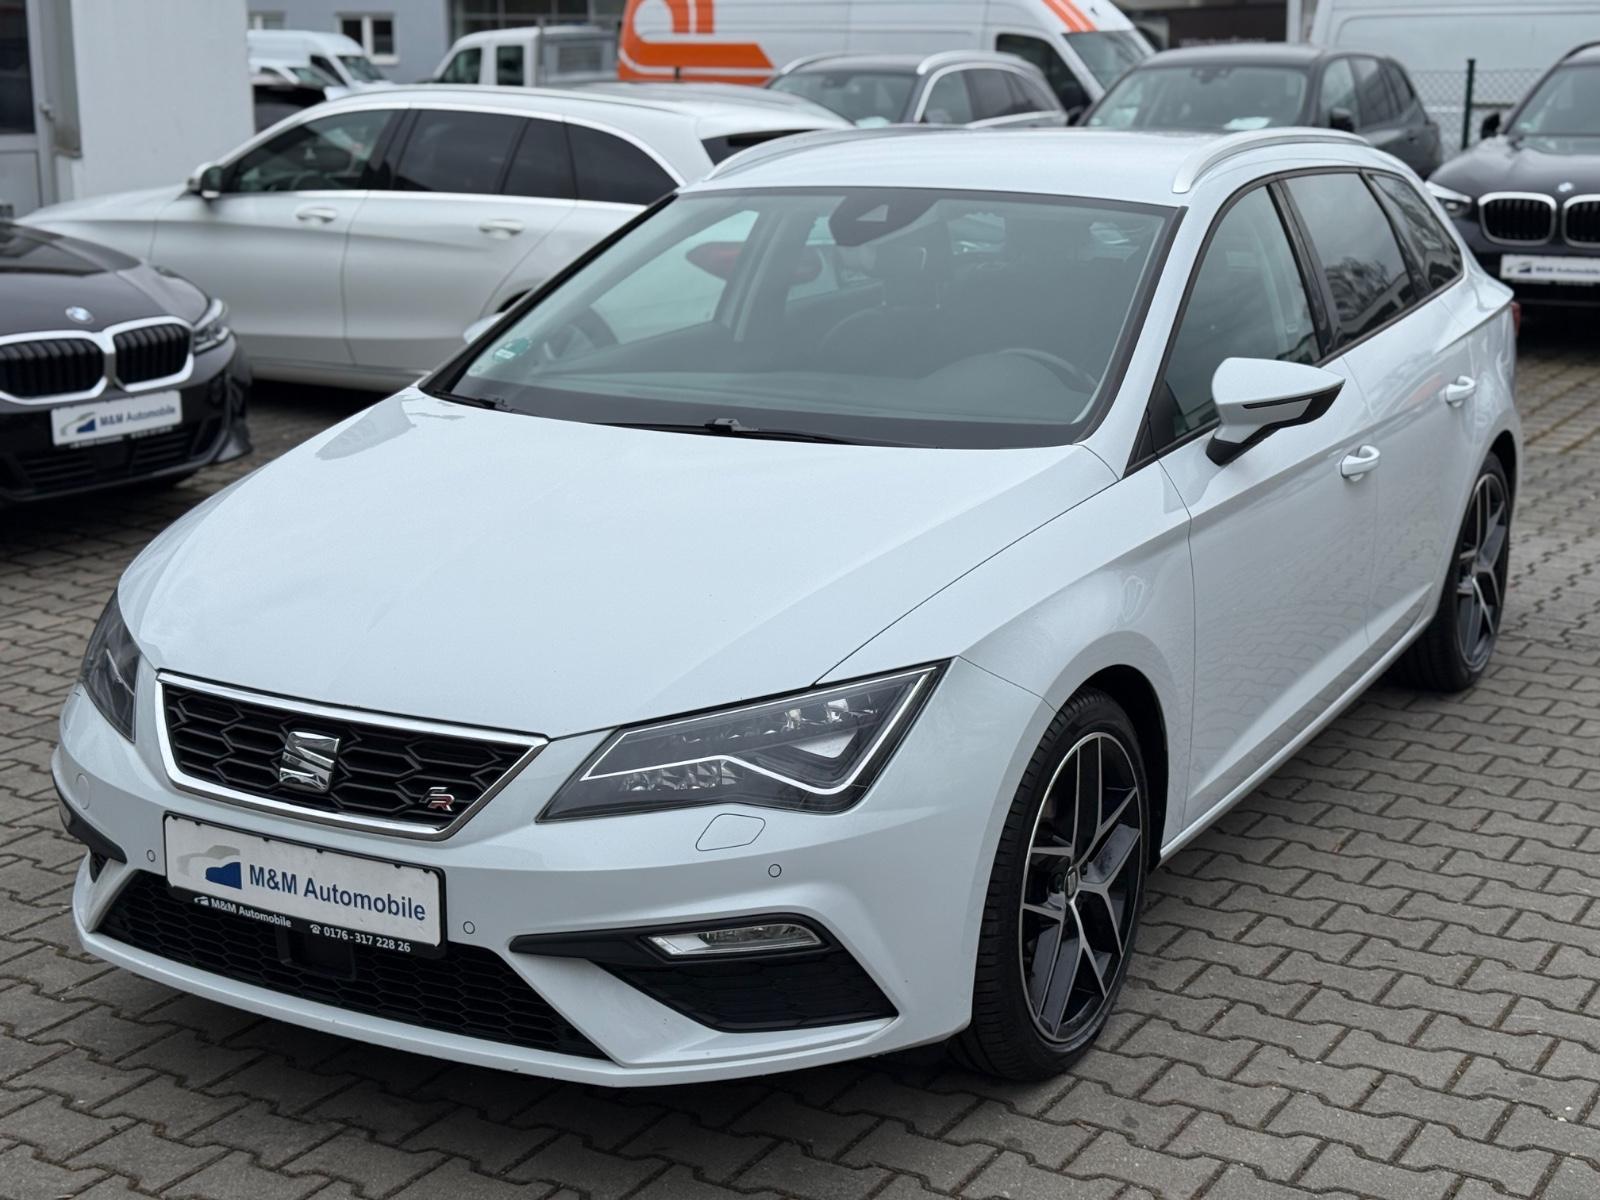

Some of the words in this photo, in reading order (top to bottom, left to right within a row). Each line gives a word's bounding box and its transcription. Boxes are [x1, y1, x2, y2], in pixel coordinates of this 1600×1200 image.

[249, 864, 298, 895] M&M
[303, 877, 426, 921] Automobile
[210, 898, 237, 914] M&M
[238, 906, 292, 928] Automobile
[375, 937, 396, 950] 228
[397, 941, 411, 953] 26
